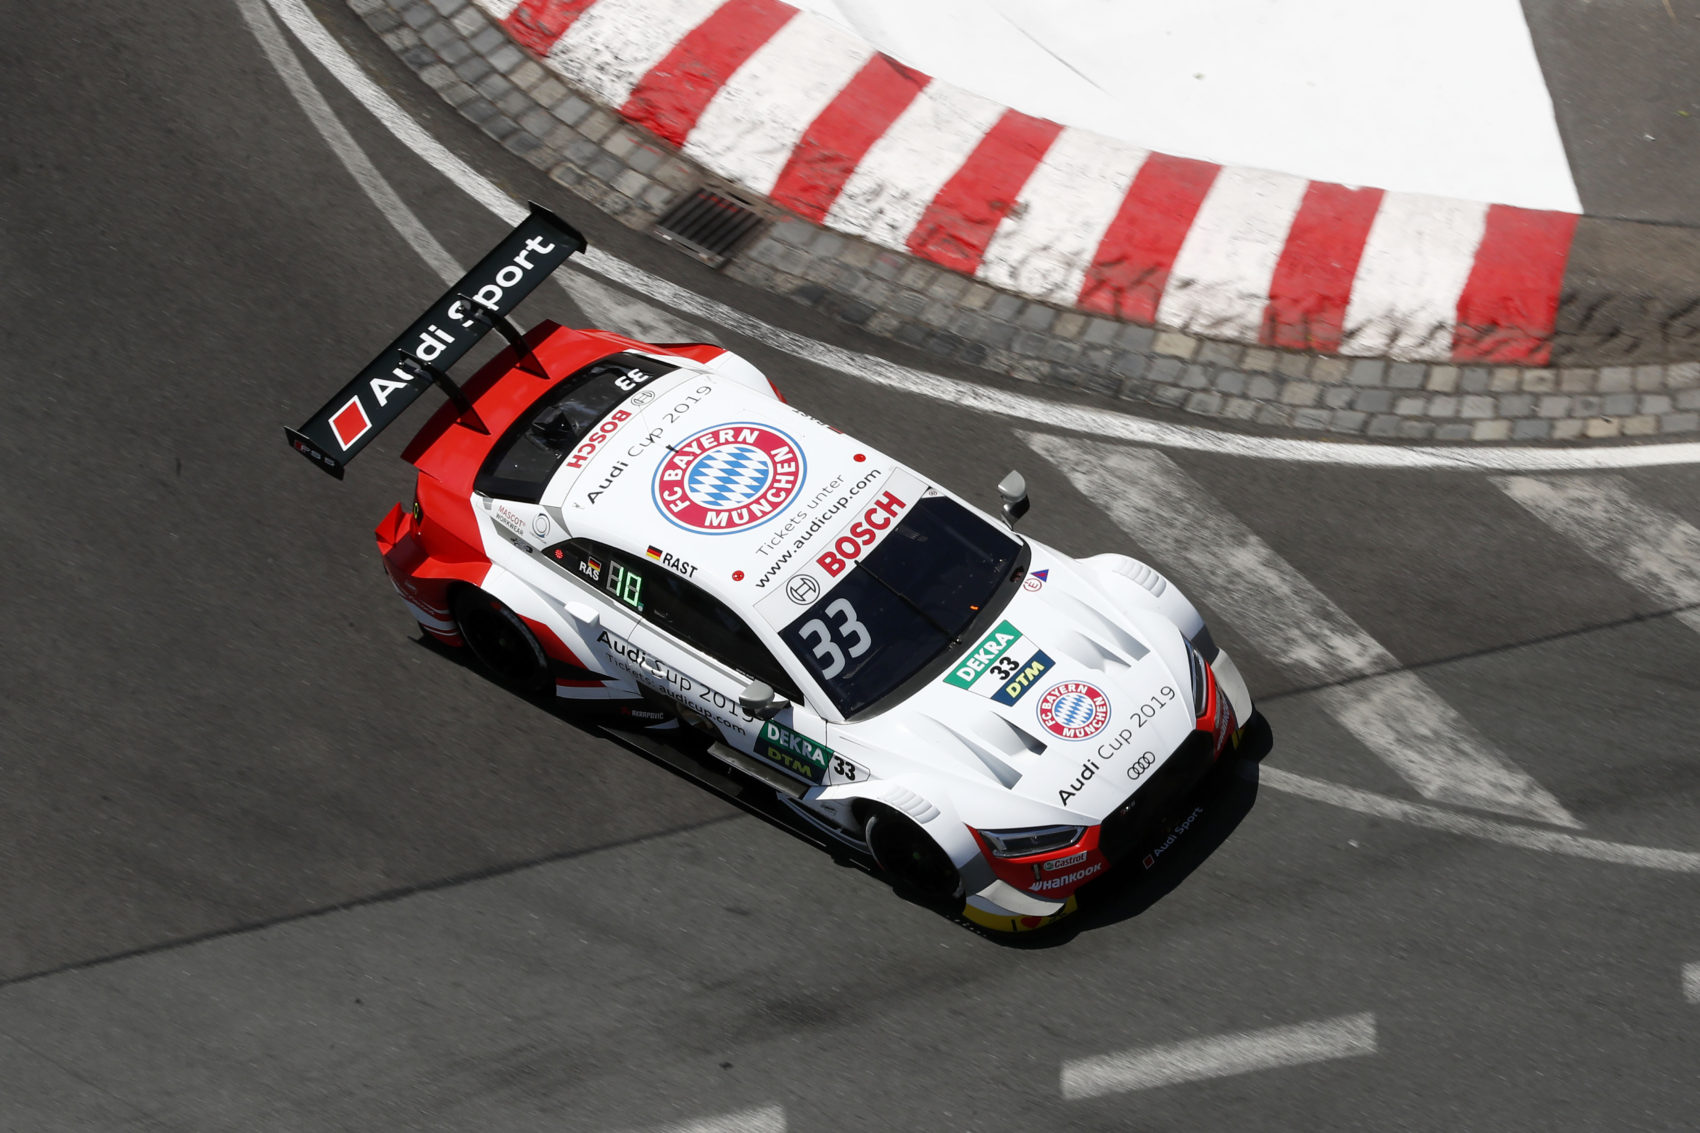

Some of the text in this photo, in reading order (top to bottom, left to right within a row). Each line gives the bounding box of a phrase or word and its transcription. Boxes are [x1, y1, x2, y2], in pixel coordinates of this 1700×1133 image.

[566, 409, 632, 469] BOSCH
[587, 385, 712, 504] Audi Cup 2019
[662, 428, 760, 513] FC BAYERN
[704, 445, 797, 527] MÜNCHEN
[755, 474, 845, 556] Tickets unter
[755, 468, 882, 589] www.audicup.com
[816, 490, 907, 578] BOSCH
[662, 552, 698, 579] RAST
[798, 598, 872, 680] 33
[956, 632, 1014, 682] DEKRA
[597, 630, 647, 667] Audi
[699, 682, 755, 723] 201
[989, 656, 1020, 681] 33
[1005, 660, 1046, 698] DTM
[1041, 683, 1088, 727] FC BAYERN
[767, 722, 826, 766] DEKRA
[767, 747, 813, 778] DTM
[833, 755, 856, 781] 33
[1058, 685, 1176, 807] Audi Cup 2019
[1154, 807, 1203, 857] Audi Sport
[1054, 853, 1085, 868] Castrol
